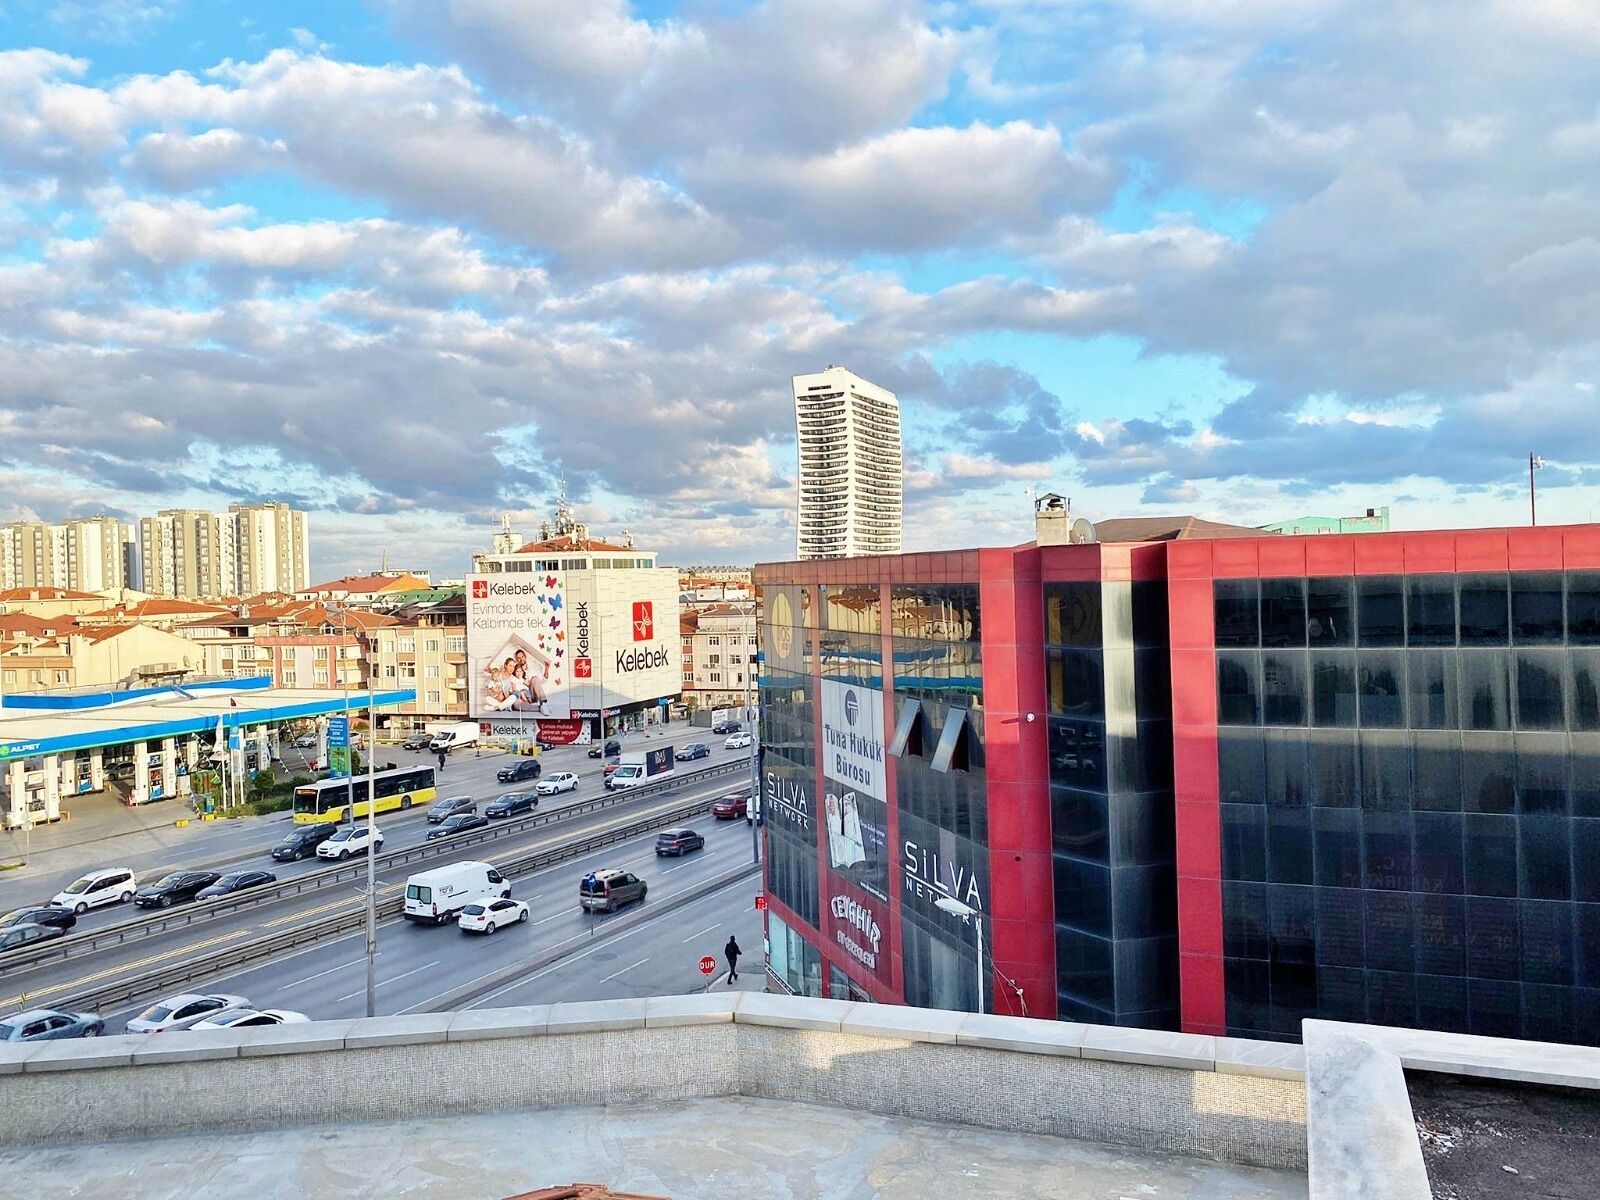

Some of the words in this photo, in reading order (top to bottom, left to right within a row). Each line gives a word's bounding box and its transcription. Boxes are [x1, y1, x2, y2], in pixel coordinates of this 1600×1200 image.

[490, 582, 536, 595] Kelebek
[472, 602, 513, 615] Evimde
[472, 617, 524, 629] Kalbimde
[576, 601, 589, 658] Kelebek
[616, 644, 669, 674] Kelebek
[492, 724, 528, 736] Kelebek
[10, 743, 41, 753] ALPET
[825, 724, 847, 750] Tuna
[850, 732, 882, 762] Hukuk
[836, 753, 871, 786] Bürosu
[768, 798, 809, 830] NETWORK
[700, 960, 715, 970] DUR
